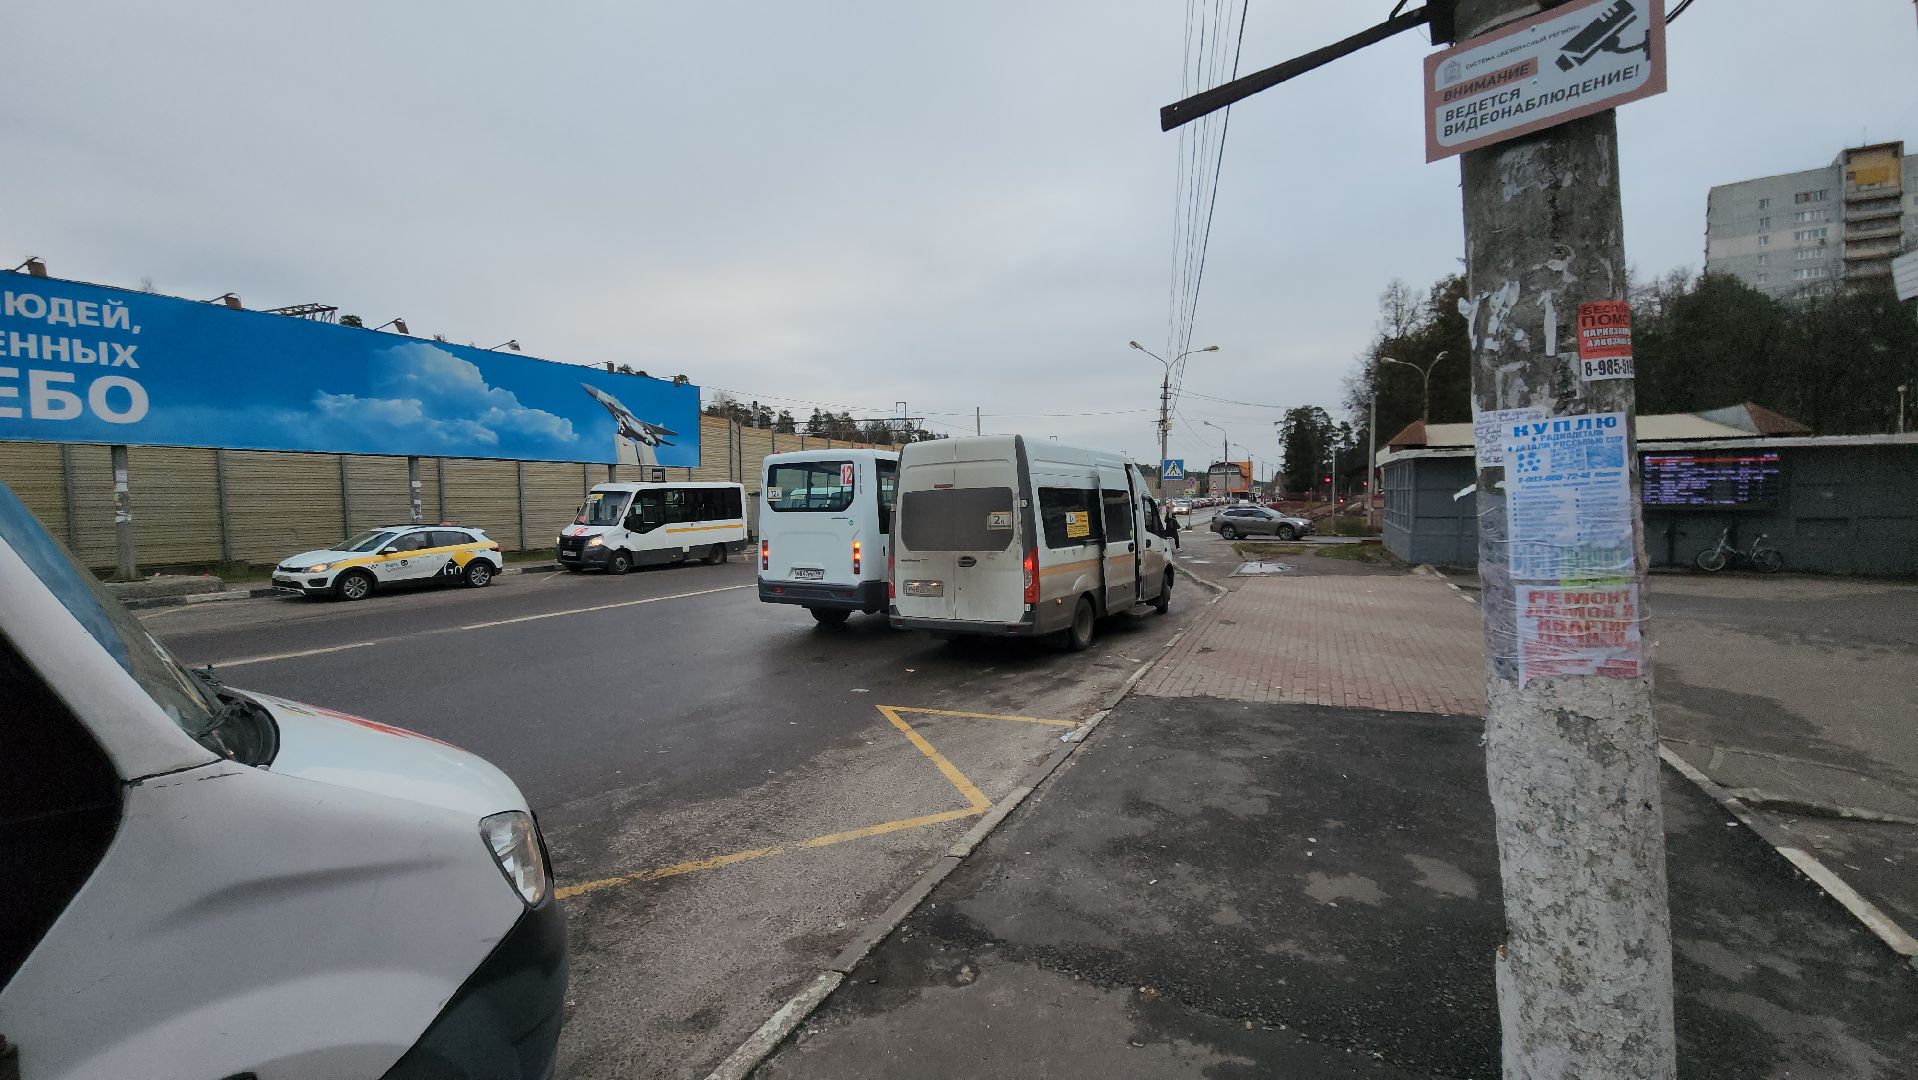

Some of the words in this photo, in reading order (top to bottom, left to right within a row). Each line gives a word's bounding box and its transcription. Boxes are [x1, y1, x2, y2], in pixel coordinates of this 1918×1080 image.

[1465, 56, 1495, 69] СИСТЕМА
[1444, 62, 1531, 101] ВНИМАНИЕ
[1444, 63, 1640, 137] ВИДЕОНАБЛЮДЕНИЕ!
[1445, 87, 1521, 122] ВЕДЕТСЯ
[0, 290, 142, 334] ЮДЕЙ,
[1513, 416, 1617, 437] КУПЛЮ
[841, 465, 853, 485] 12
[443, 561, 463, 576] Go
